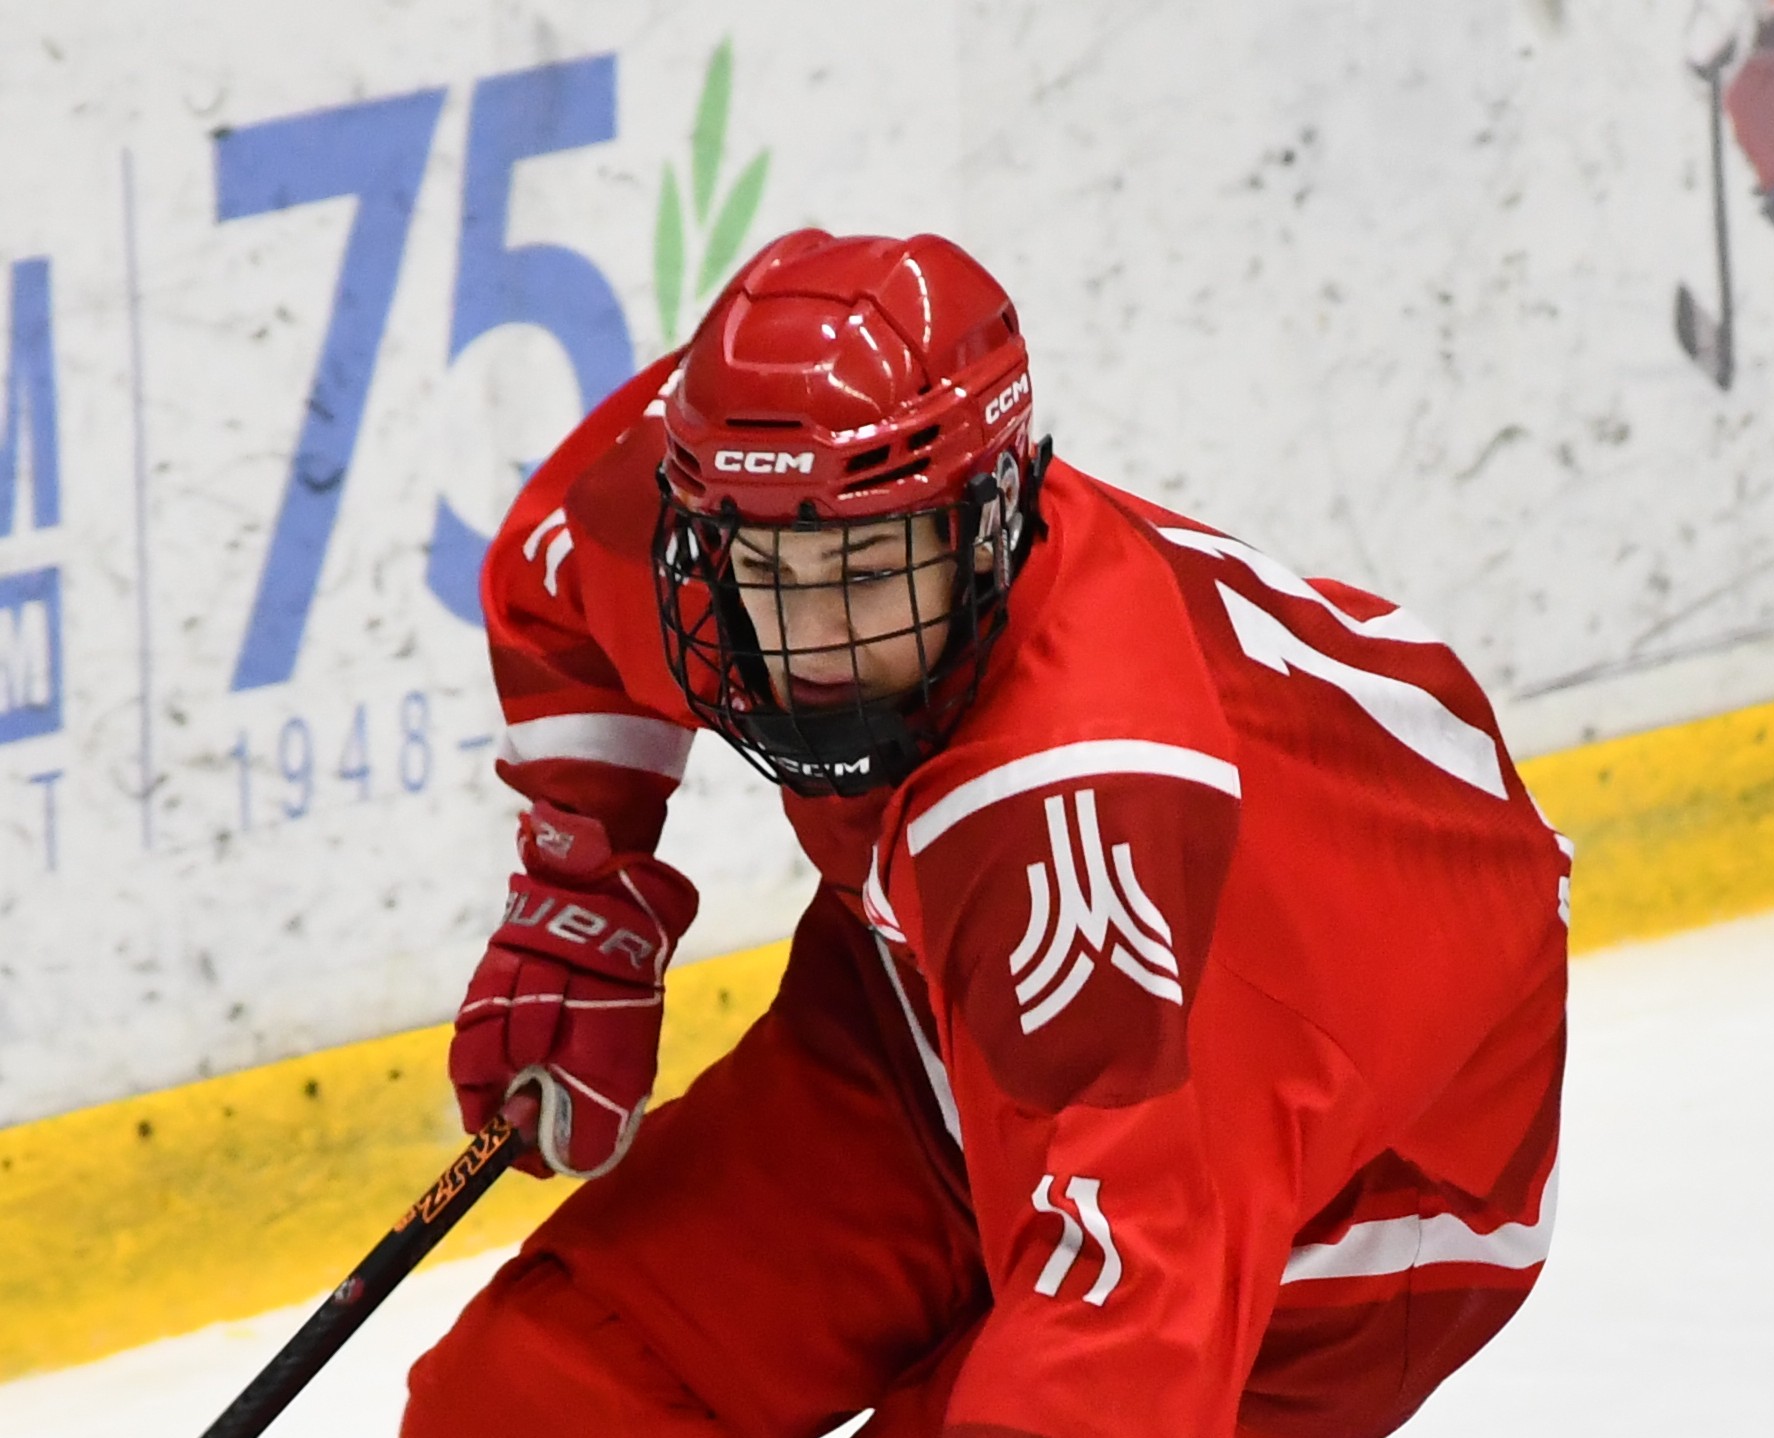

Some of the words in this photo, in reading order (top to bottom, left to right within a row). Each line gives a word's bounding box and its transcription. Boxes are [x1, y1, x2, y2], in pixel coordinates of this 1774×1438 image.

[213, 51, 637, 692] 75
[985, 372, 1029, 425] CCM
[714, 450, 815, 475] CCM
[1031, 1174, 1122, 1307] 11
